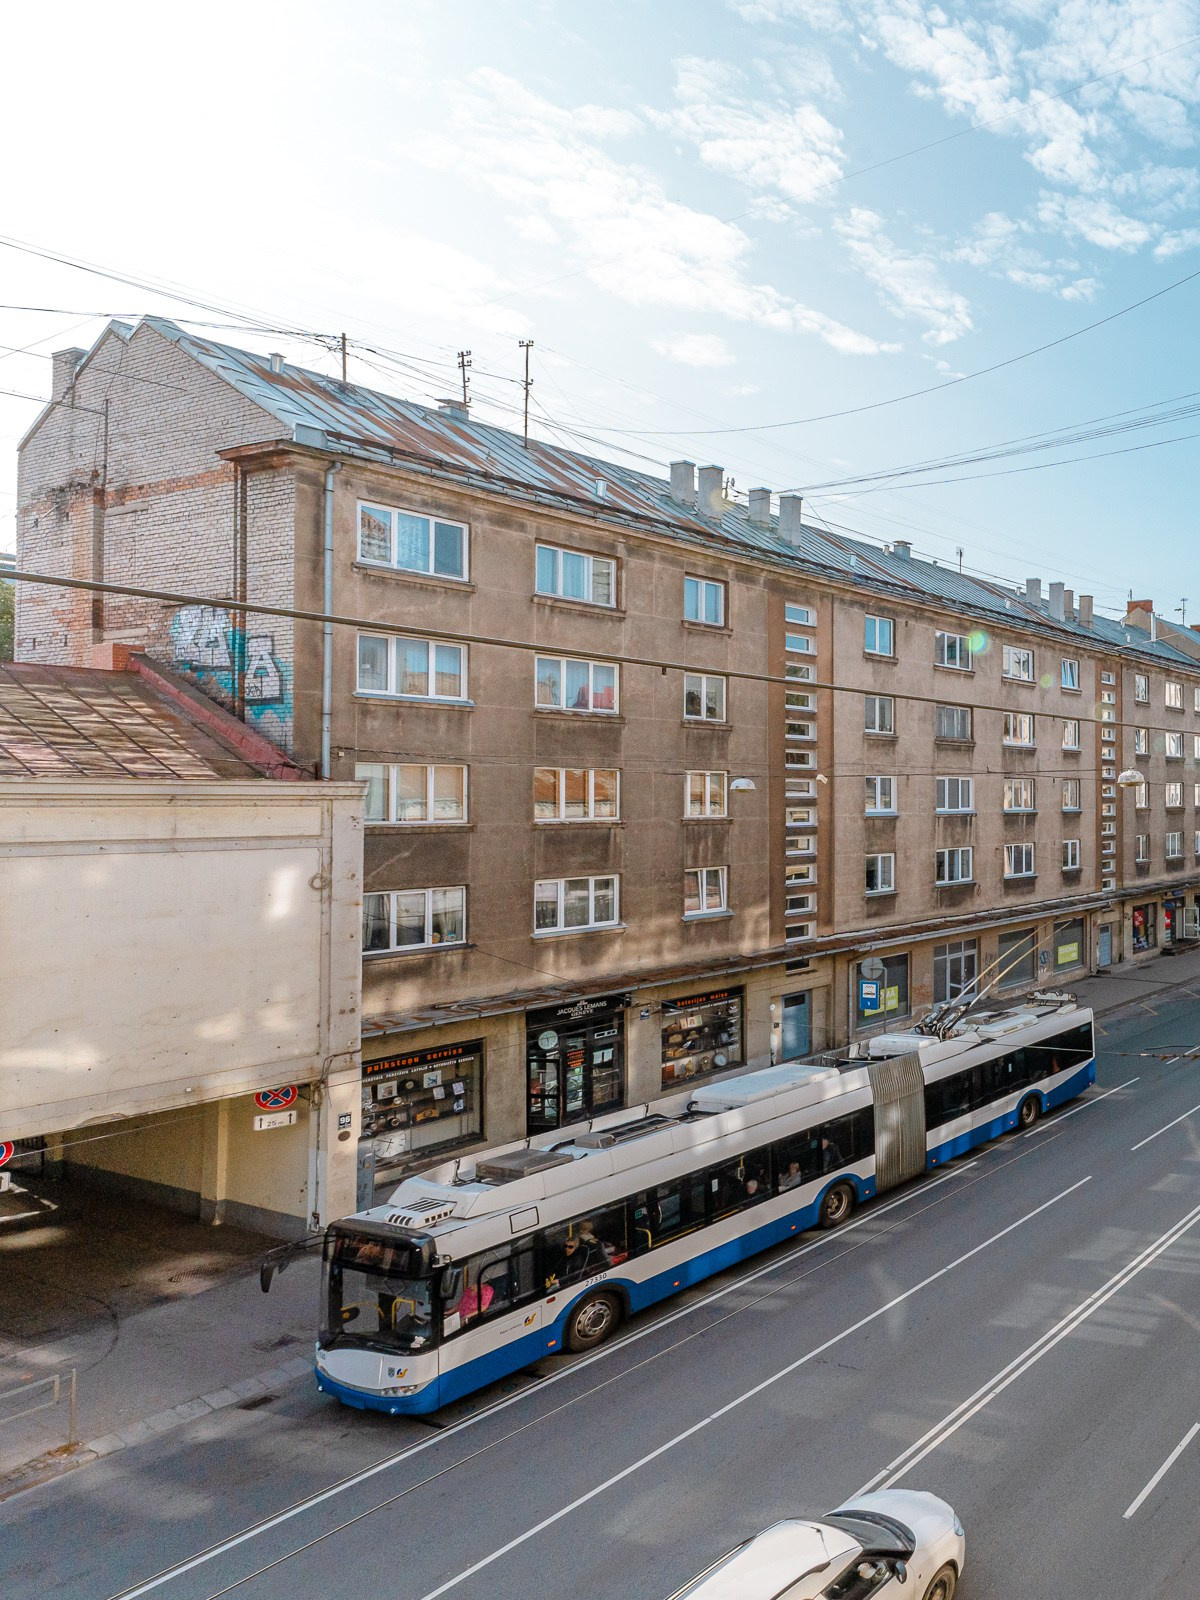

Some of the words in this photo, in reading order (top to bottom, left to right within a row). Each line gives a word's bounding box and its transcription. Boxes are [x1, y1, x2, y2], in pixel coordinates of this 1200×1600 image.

[556, 1005, 583, 1016] JACQUES
[583, 1000, 607, 1010] LEMANS
[366, 1056, 420, 1074] pulksteņu
[426, 1047, 463, 1061] serviss
[339, 1115, 351, 1125] 96
[585, 1273, 608, 1287] 27330
